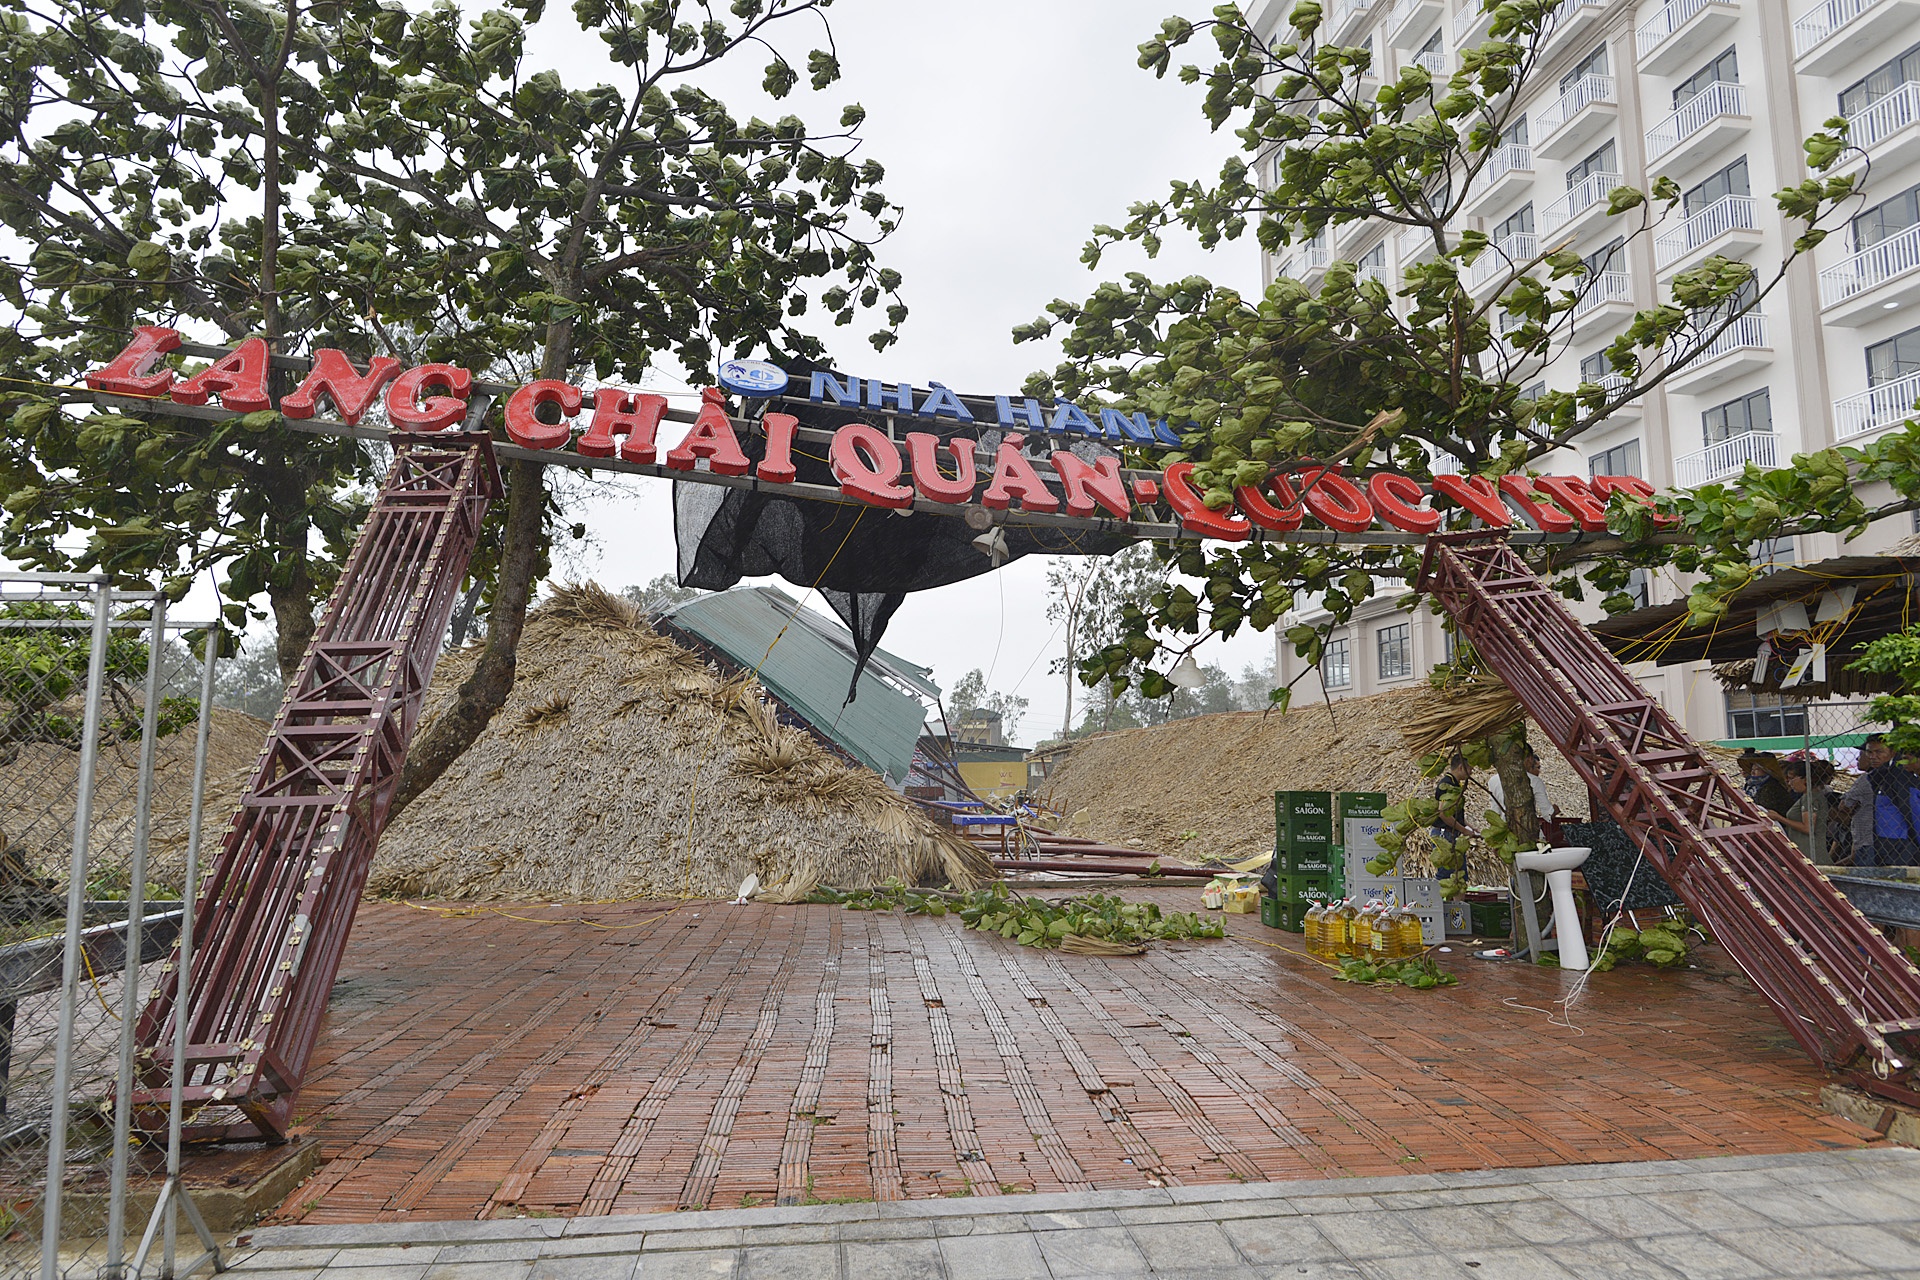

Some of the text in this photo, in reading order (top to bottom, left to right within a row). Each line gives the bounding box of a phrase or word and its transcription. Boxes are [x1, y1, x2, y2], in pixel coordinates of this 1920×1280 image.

[809, 370, 974, 424] NHÀ
[502, 386, 799, 484] CHÀI
[1294, 806, 1326, 815] SAIGON
[1360, 825, 1380, 836] Tiger
[1298, 891, 1328, 899] SAIGON
[1362, 888, 1383, 898] Tiger
